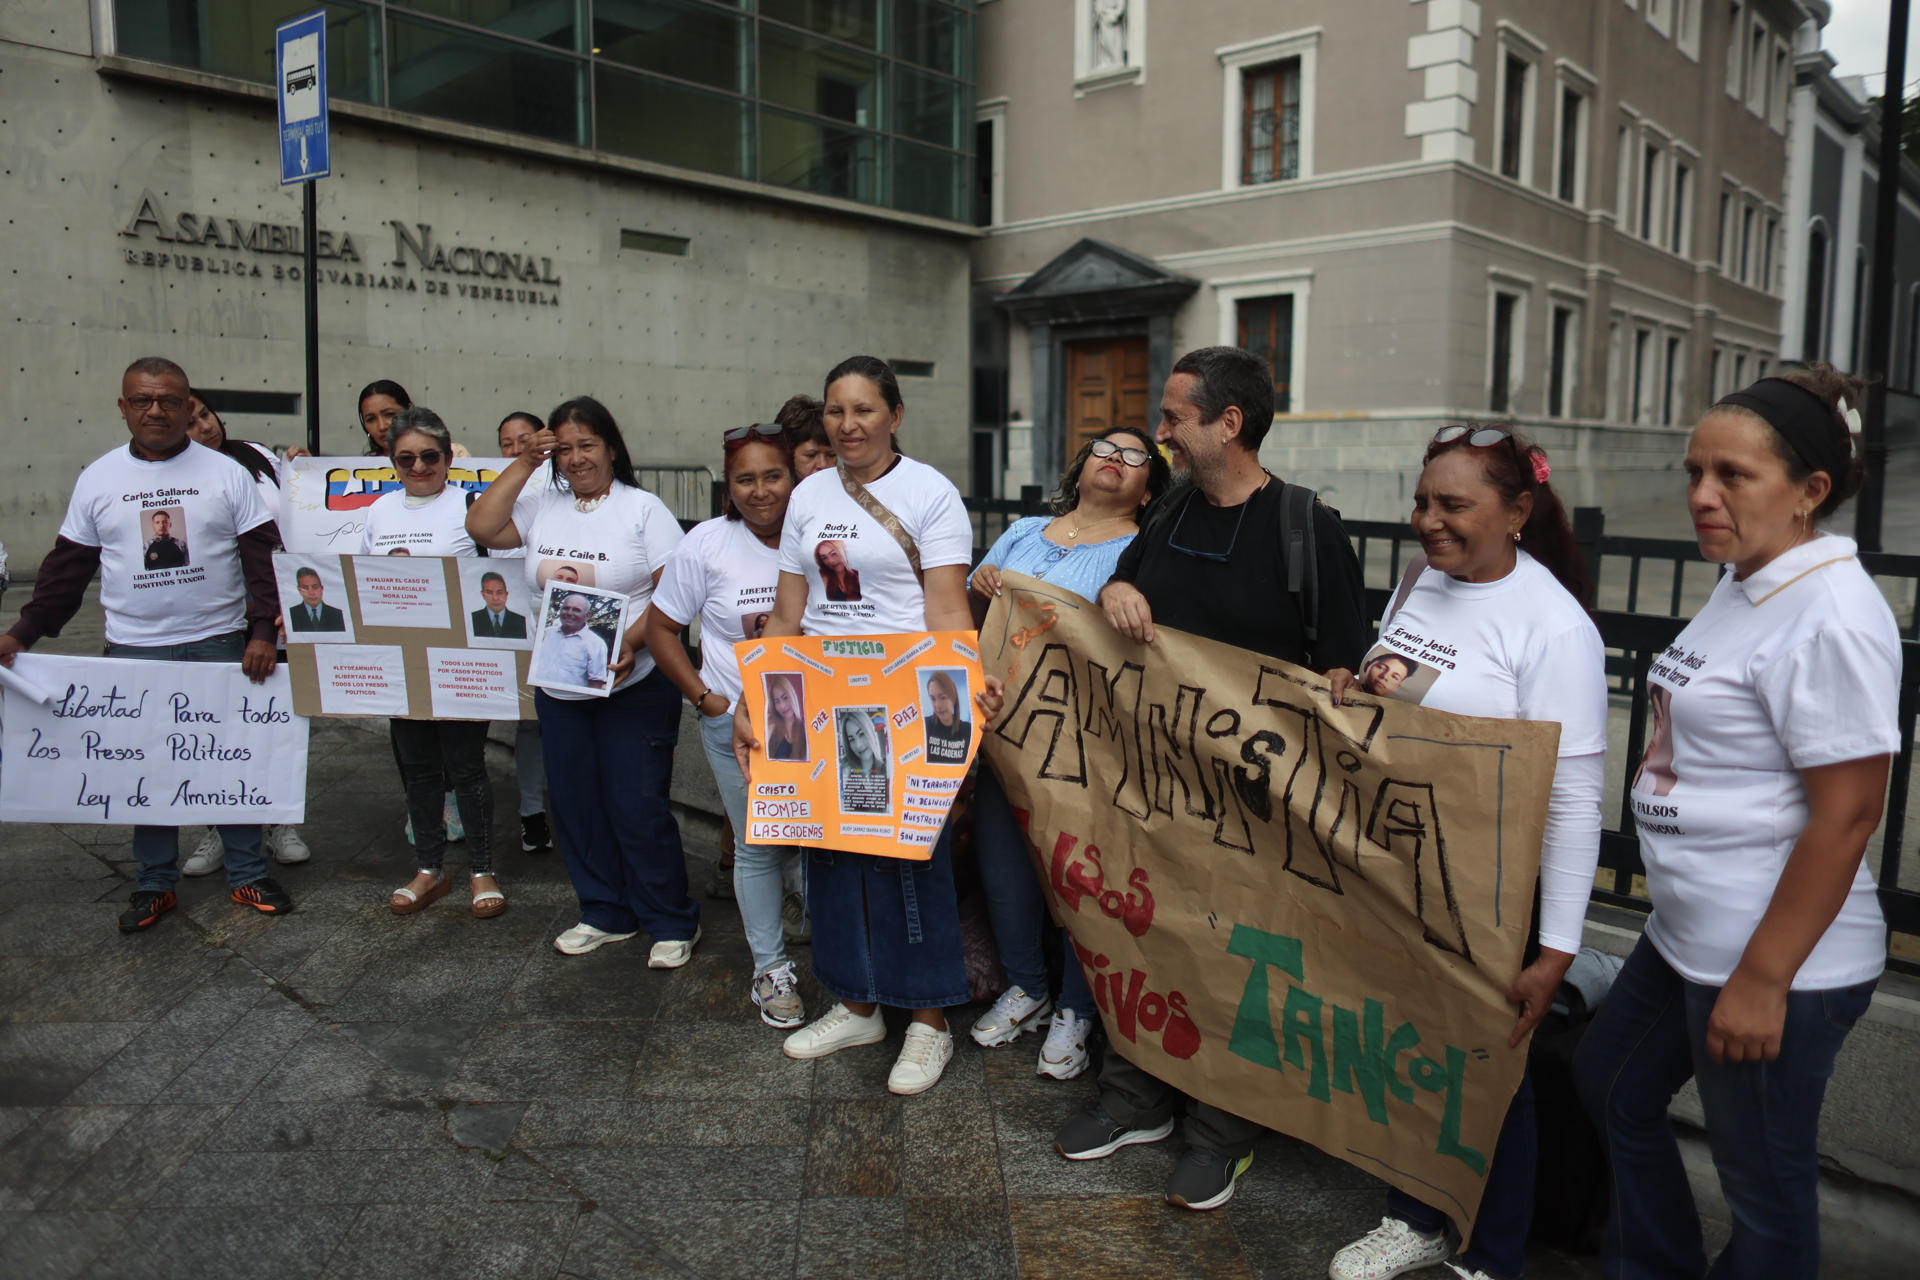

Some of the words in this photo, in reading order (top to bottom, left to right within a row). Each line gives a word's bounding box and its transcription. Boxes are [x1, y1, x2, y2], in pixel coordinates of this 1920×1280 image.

[125, 249, 262, 278] REPUBLICA
[272, 264, 417, 292] BOIVARIANA
[425, 279, 449, 296] DE
[457, 283, 559, 307] VENEZUELA
[122, 492, 154, 502] Carlos
[156, 487, 199, 497] Gallardo
[142, 497, 181, 508] Rondón
[817, 532, 848, 540] Ibarra
[850, 532, 860, 540] R.
[823, 523, 848, 533] Rudy
[850, 524, 859, 532] J.
[538, 544, 555, 556] Luis
[556, 548, 566, 557] E.
[569, 549, 596, 560] Caile
[598, 552, 610, 561] B.
[133, 572, 171, 581] LIBERTAD
[175, 566, 205, 576] FALSOS
[133, 579, 176, 590] POSITIVOS
[178, 574, 207, 585] TANCOL
[1392, 627, 1424, 645] Erwin
[1424, 639, 1458, 657] Jesús
[1417, 649, 1456, 670] Izarra
[1680, 650, 1708, 670] Jesús
[52, 683, 149, 719] Libertad
[169, 692, 221, 725] Para
[238, 696, 291, 724] todos
[811, 711, 829, 732] PAZ
[892, 705, 918, 727] PAZ
[27, 727, 61, 760] Los
[80, 730, 145, 761] Presos
[76, 772, 112, 820] Ley
[126, 776, 152, 808] de
[170, 779, 273, 807] Amnistía
[758, 785, 795, 795] CRISTO
[754, 800, 809, 817] ROMPE
[907, 797, 915, 805] NI
[1637, 801, 1679, 818] FALSOS
[753, 823, 780, 838] LAS
[782, 824, 824, 839] CADENAS
[899, 831, 914, 841] SON
